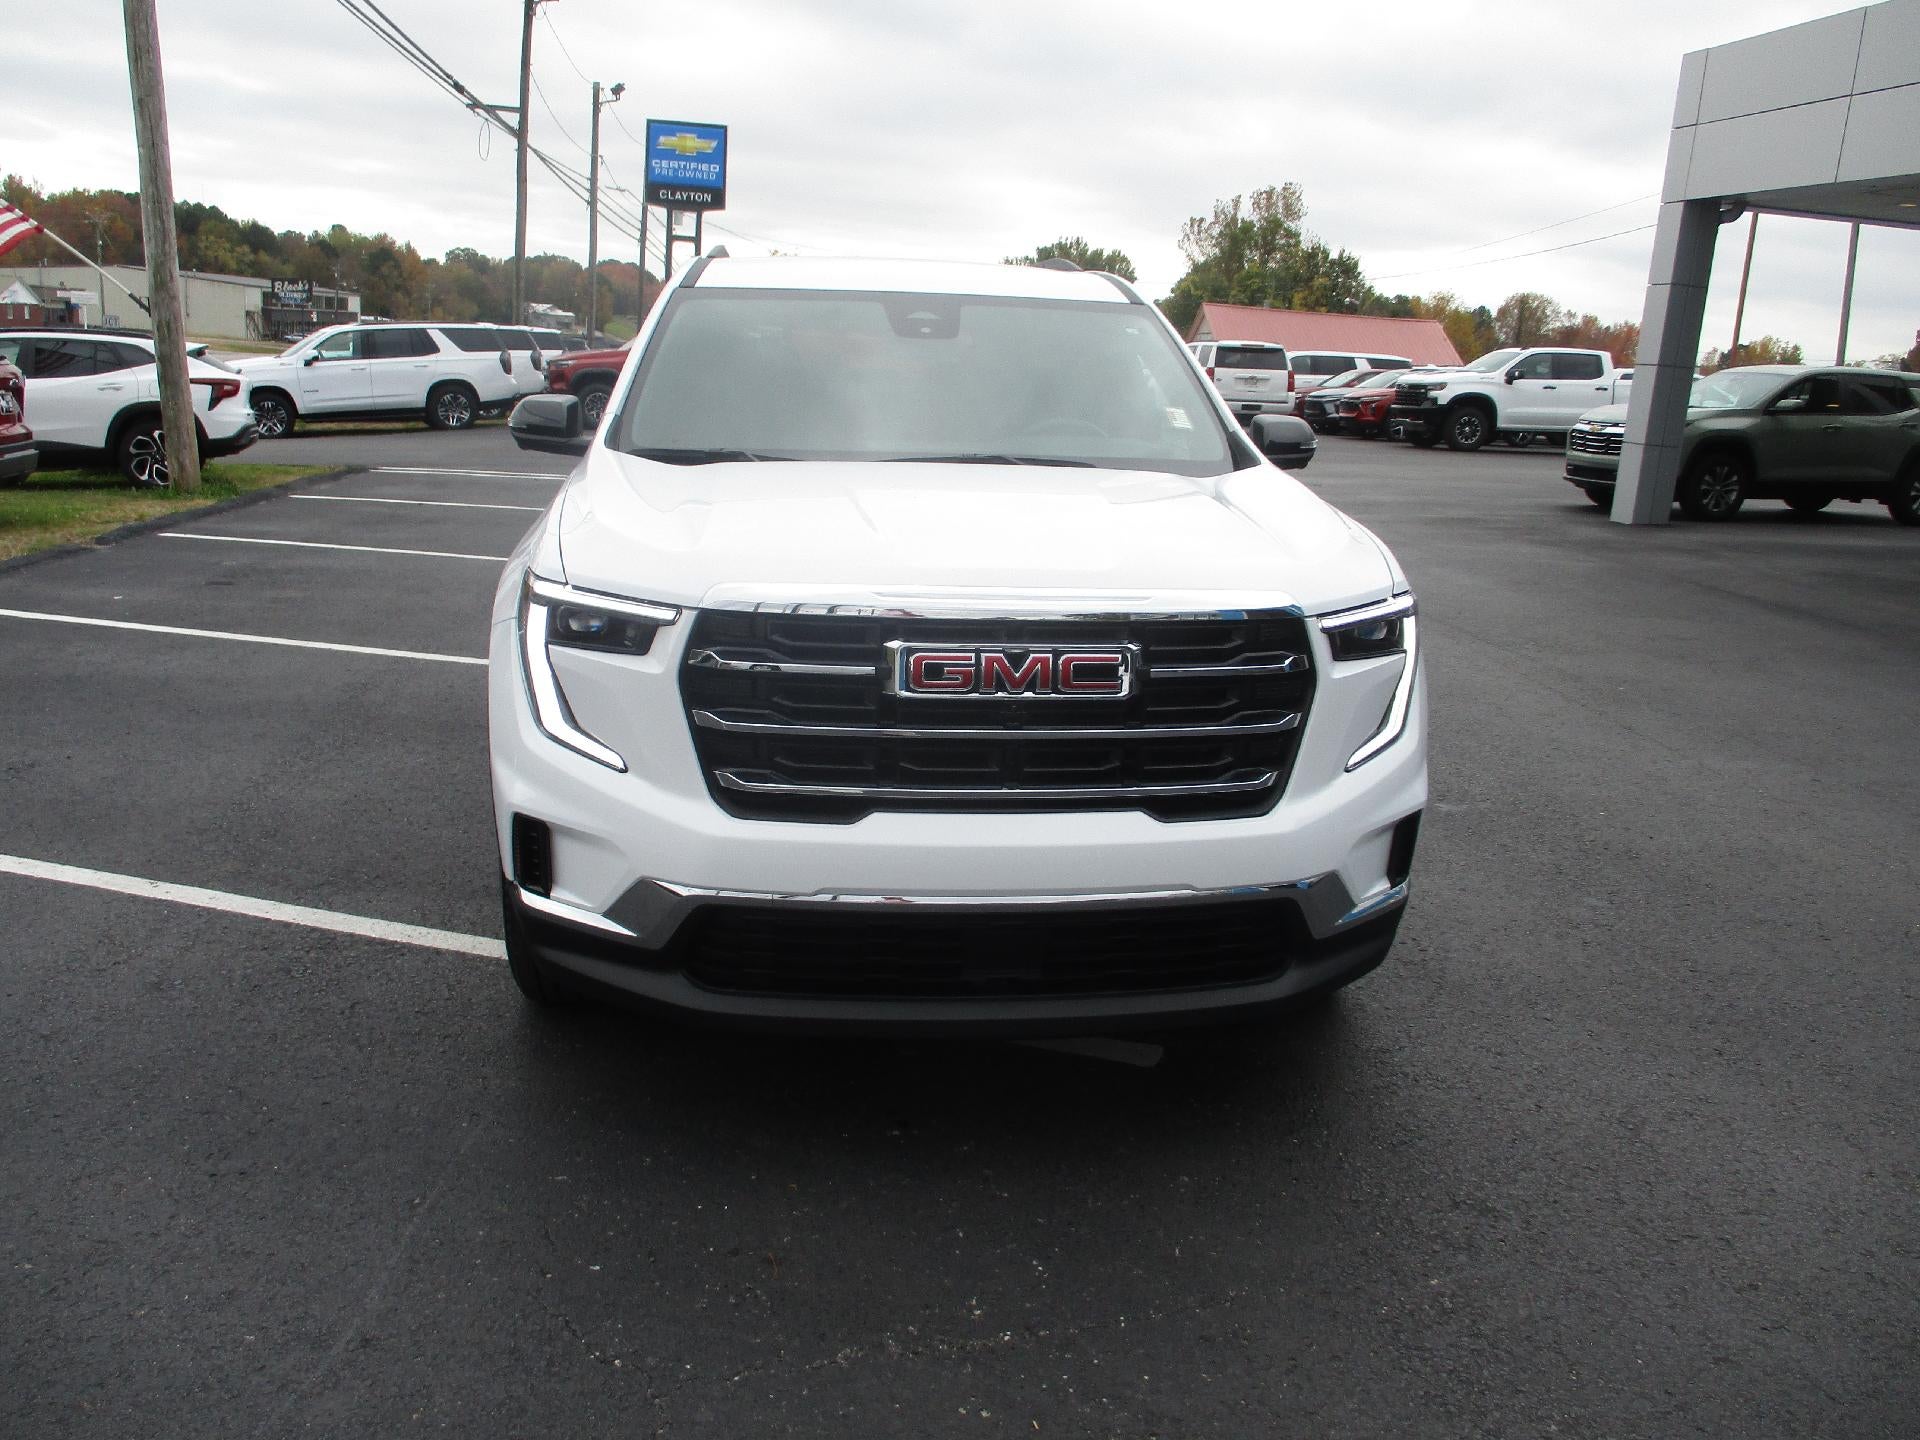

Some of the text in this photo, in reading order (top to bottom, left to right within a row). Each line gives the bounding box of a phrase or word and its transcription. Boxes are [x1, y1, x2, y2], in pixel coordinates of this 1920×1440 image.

[652, 159, 720, 172] CERTIFIED
[659, 189, 712, 202] CLAYTON
[909, 652, 1122, 693] GMC
